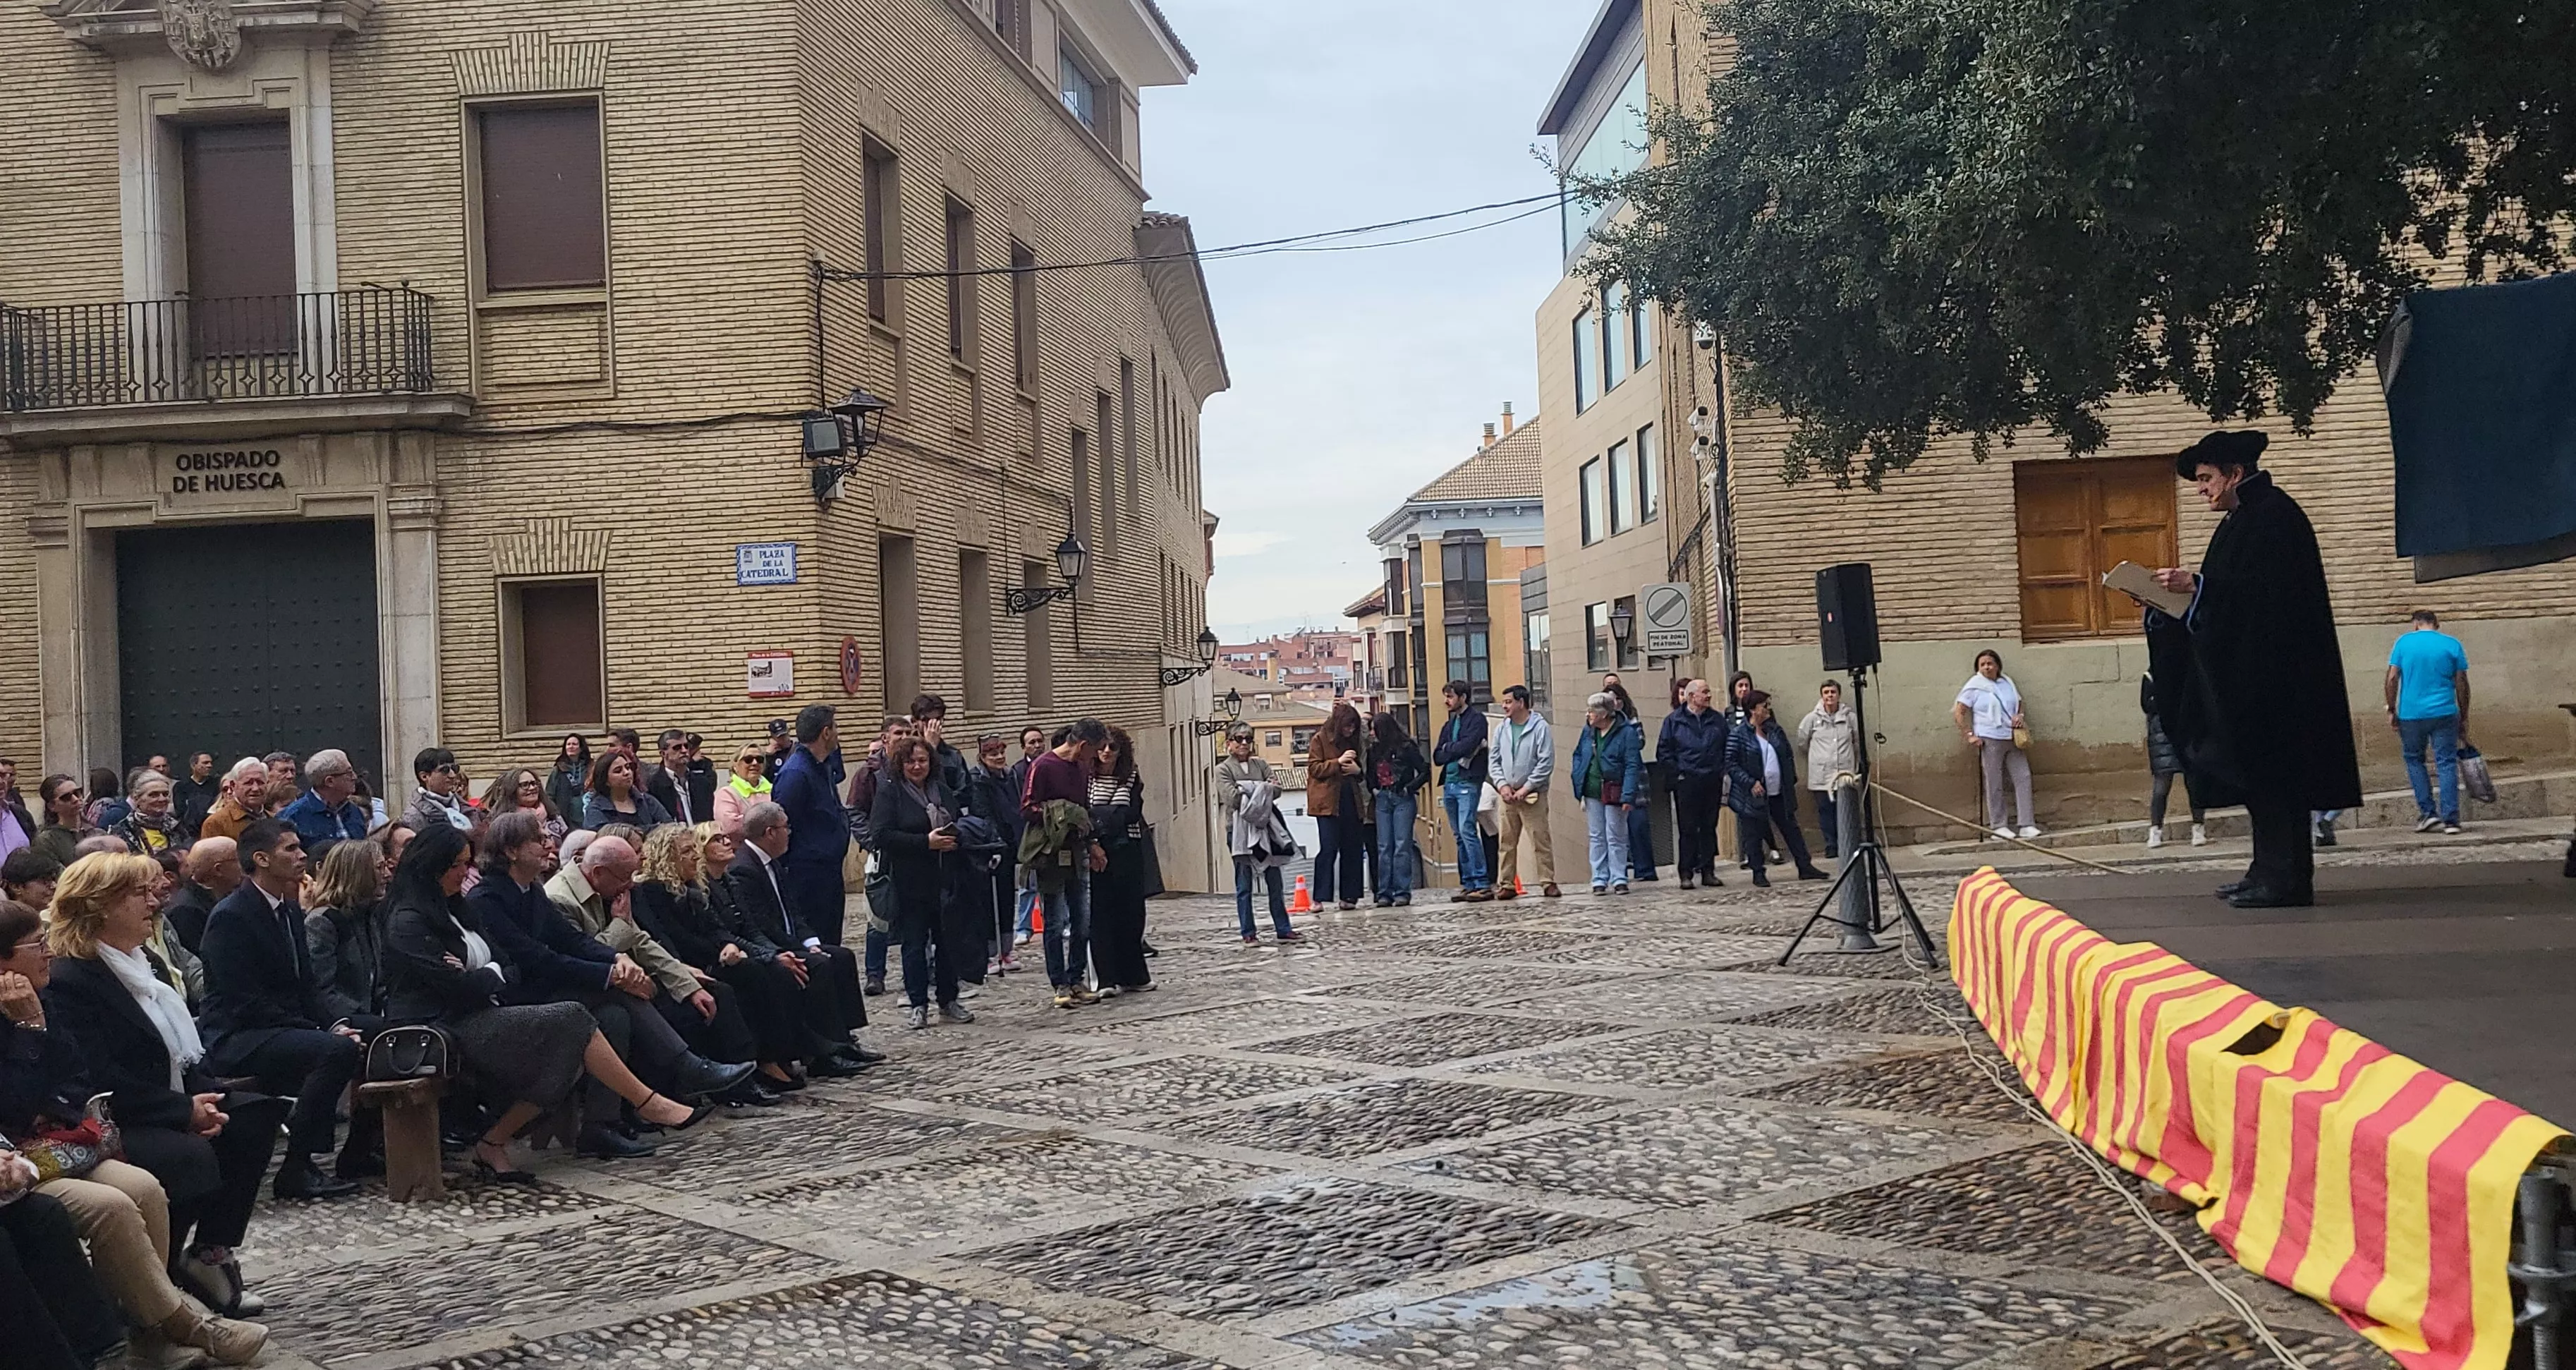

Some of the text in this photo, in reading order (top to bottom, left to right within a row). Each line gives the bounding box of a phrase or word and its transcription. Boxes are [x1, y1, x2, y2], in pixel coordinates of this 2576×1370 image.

[176, 449, 281, 471] OBISPADO
[173, 472, 286, 493] DE HUESCA
[759, 550, 784, 559] PLAZA
[741, 568, 789, 578] CATEDRAL
